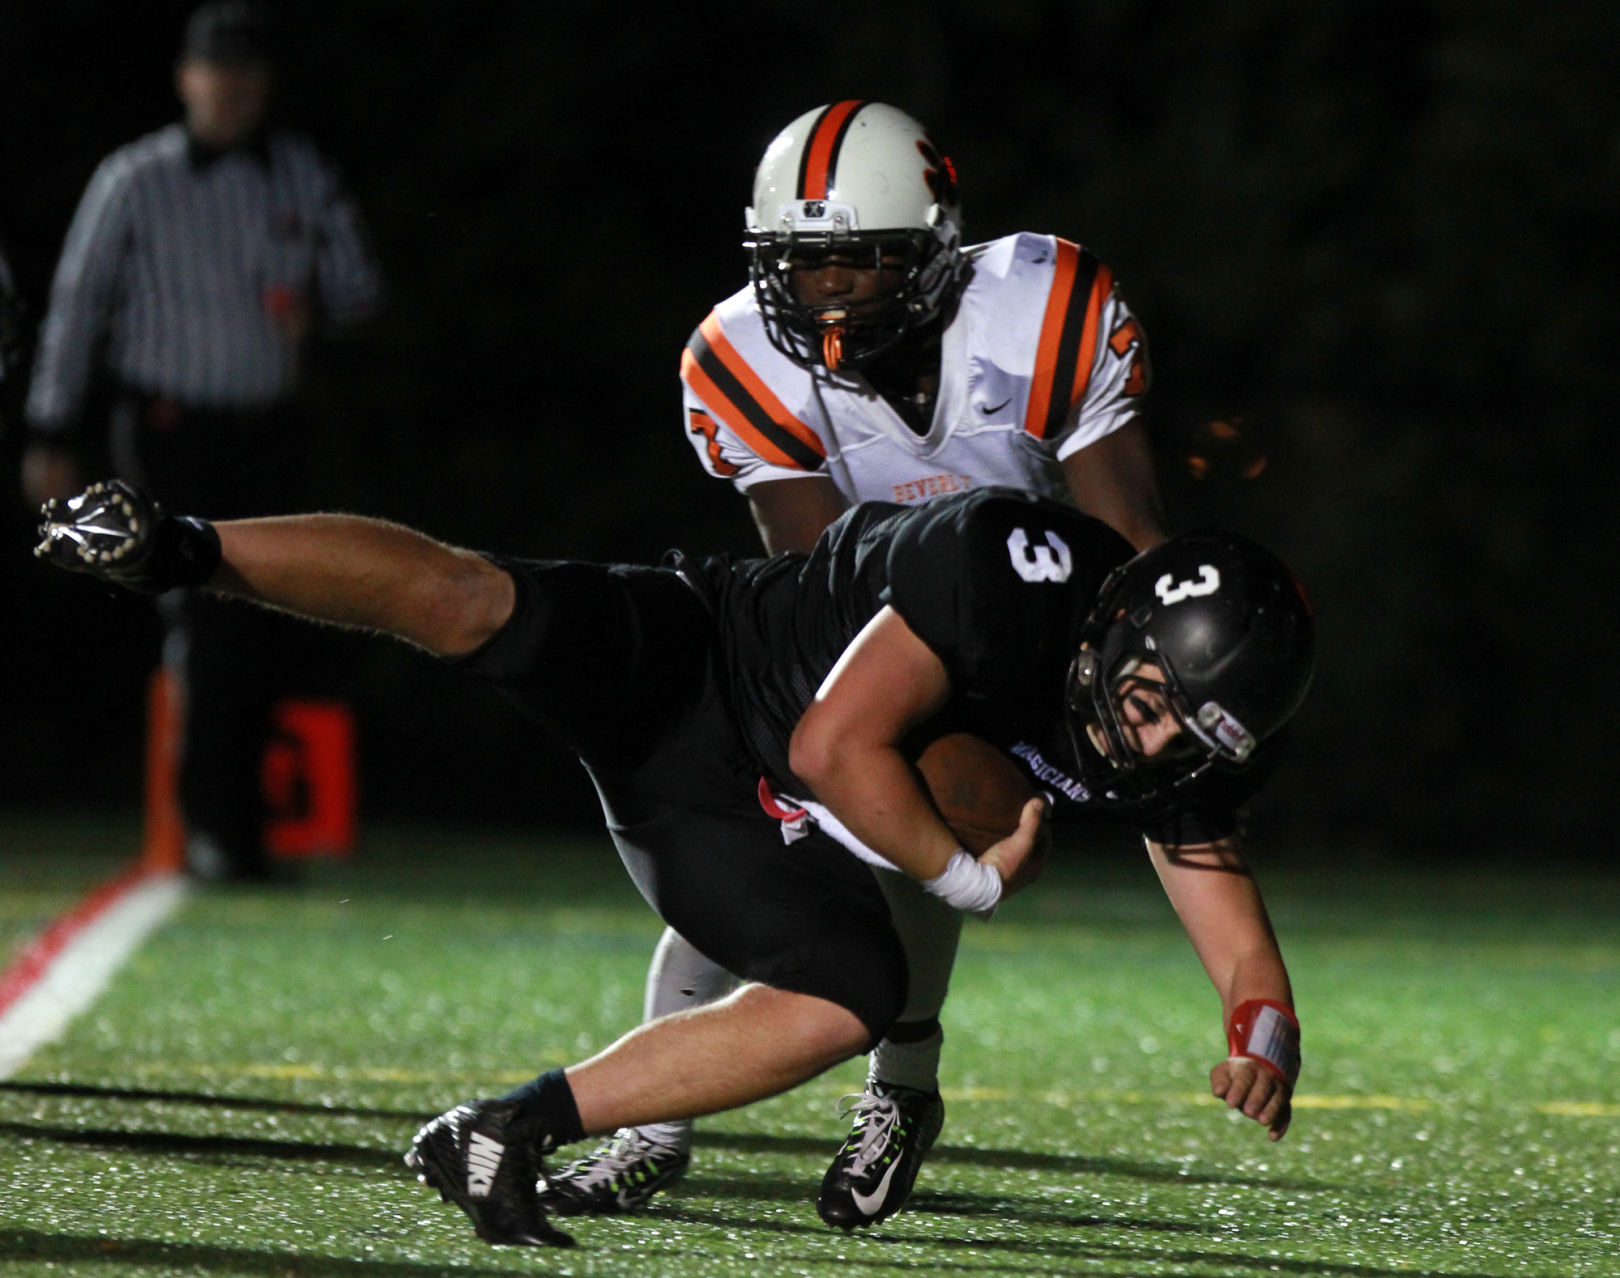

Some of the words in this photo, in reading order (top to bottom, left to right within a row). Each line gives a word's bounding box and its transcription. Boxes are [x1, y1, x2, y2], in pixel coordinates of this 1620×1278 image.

[1006, 526, 1073, 583] 3
[1154, 564, 1221, 606] 3
[467, 1131, 505, 1197] NIKE
